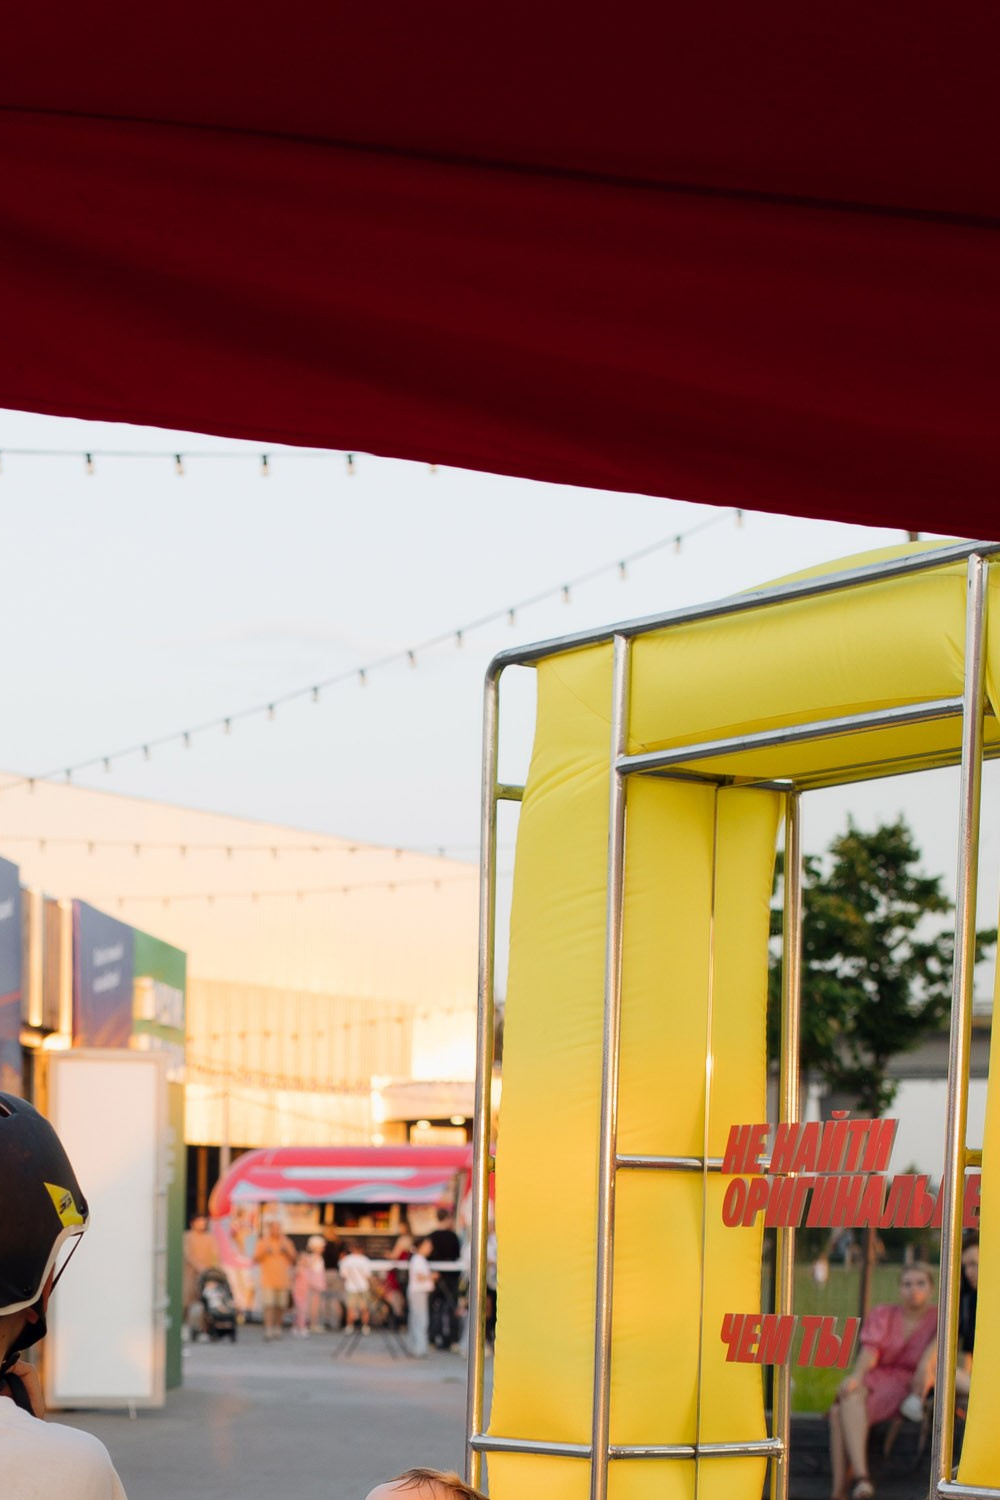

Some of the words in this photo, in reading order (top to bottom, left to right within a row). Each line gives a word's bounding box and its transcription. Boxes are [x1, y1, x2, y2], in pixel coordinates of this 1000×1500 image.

[721, 1123, 771, 1174] НЕ
[768, 1110, 898, 1173] НАЙТИ
[721, 1313, 797, 1365] ЧЕМ
[797, 1316, 860, 1369] ТЫ
